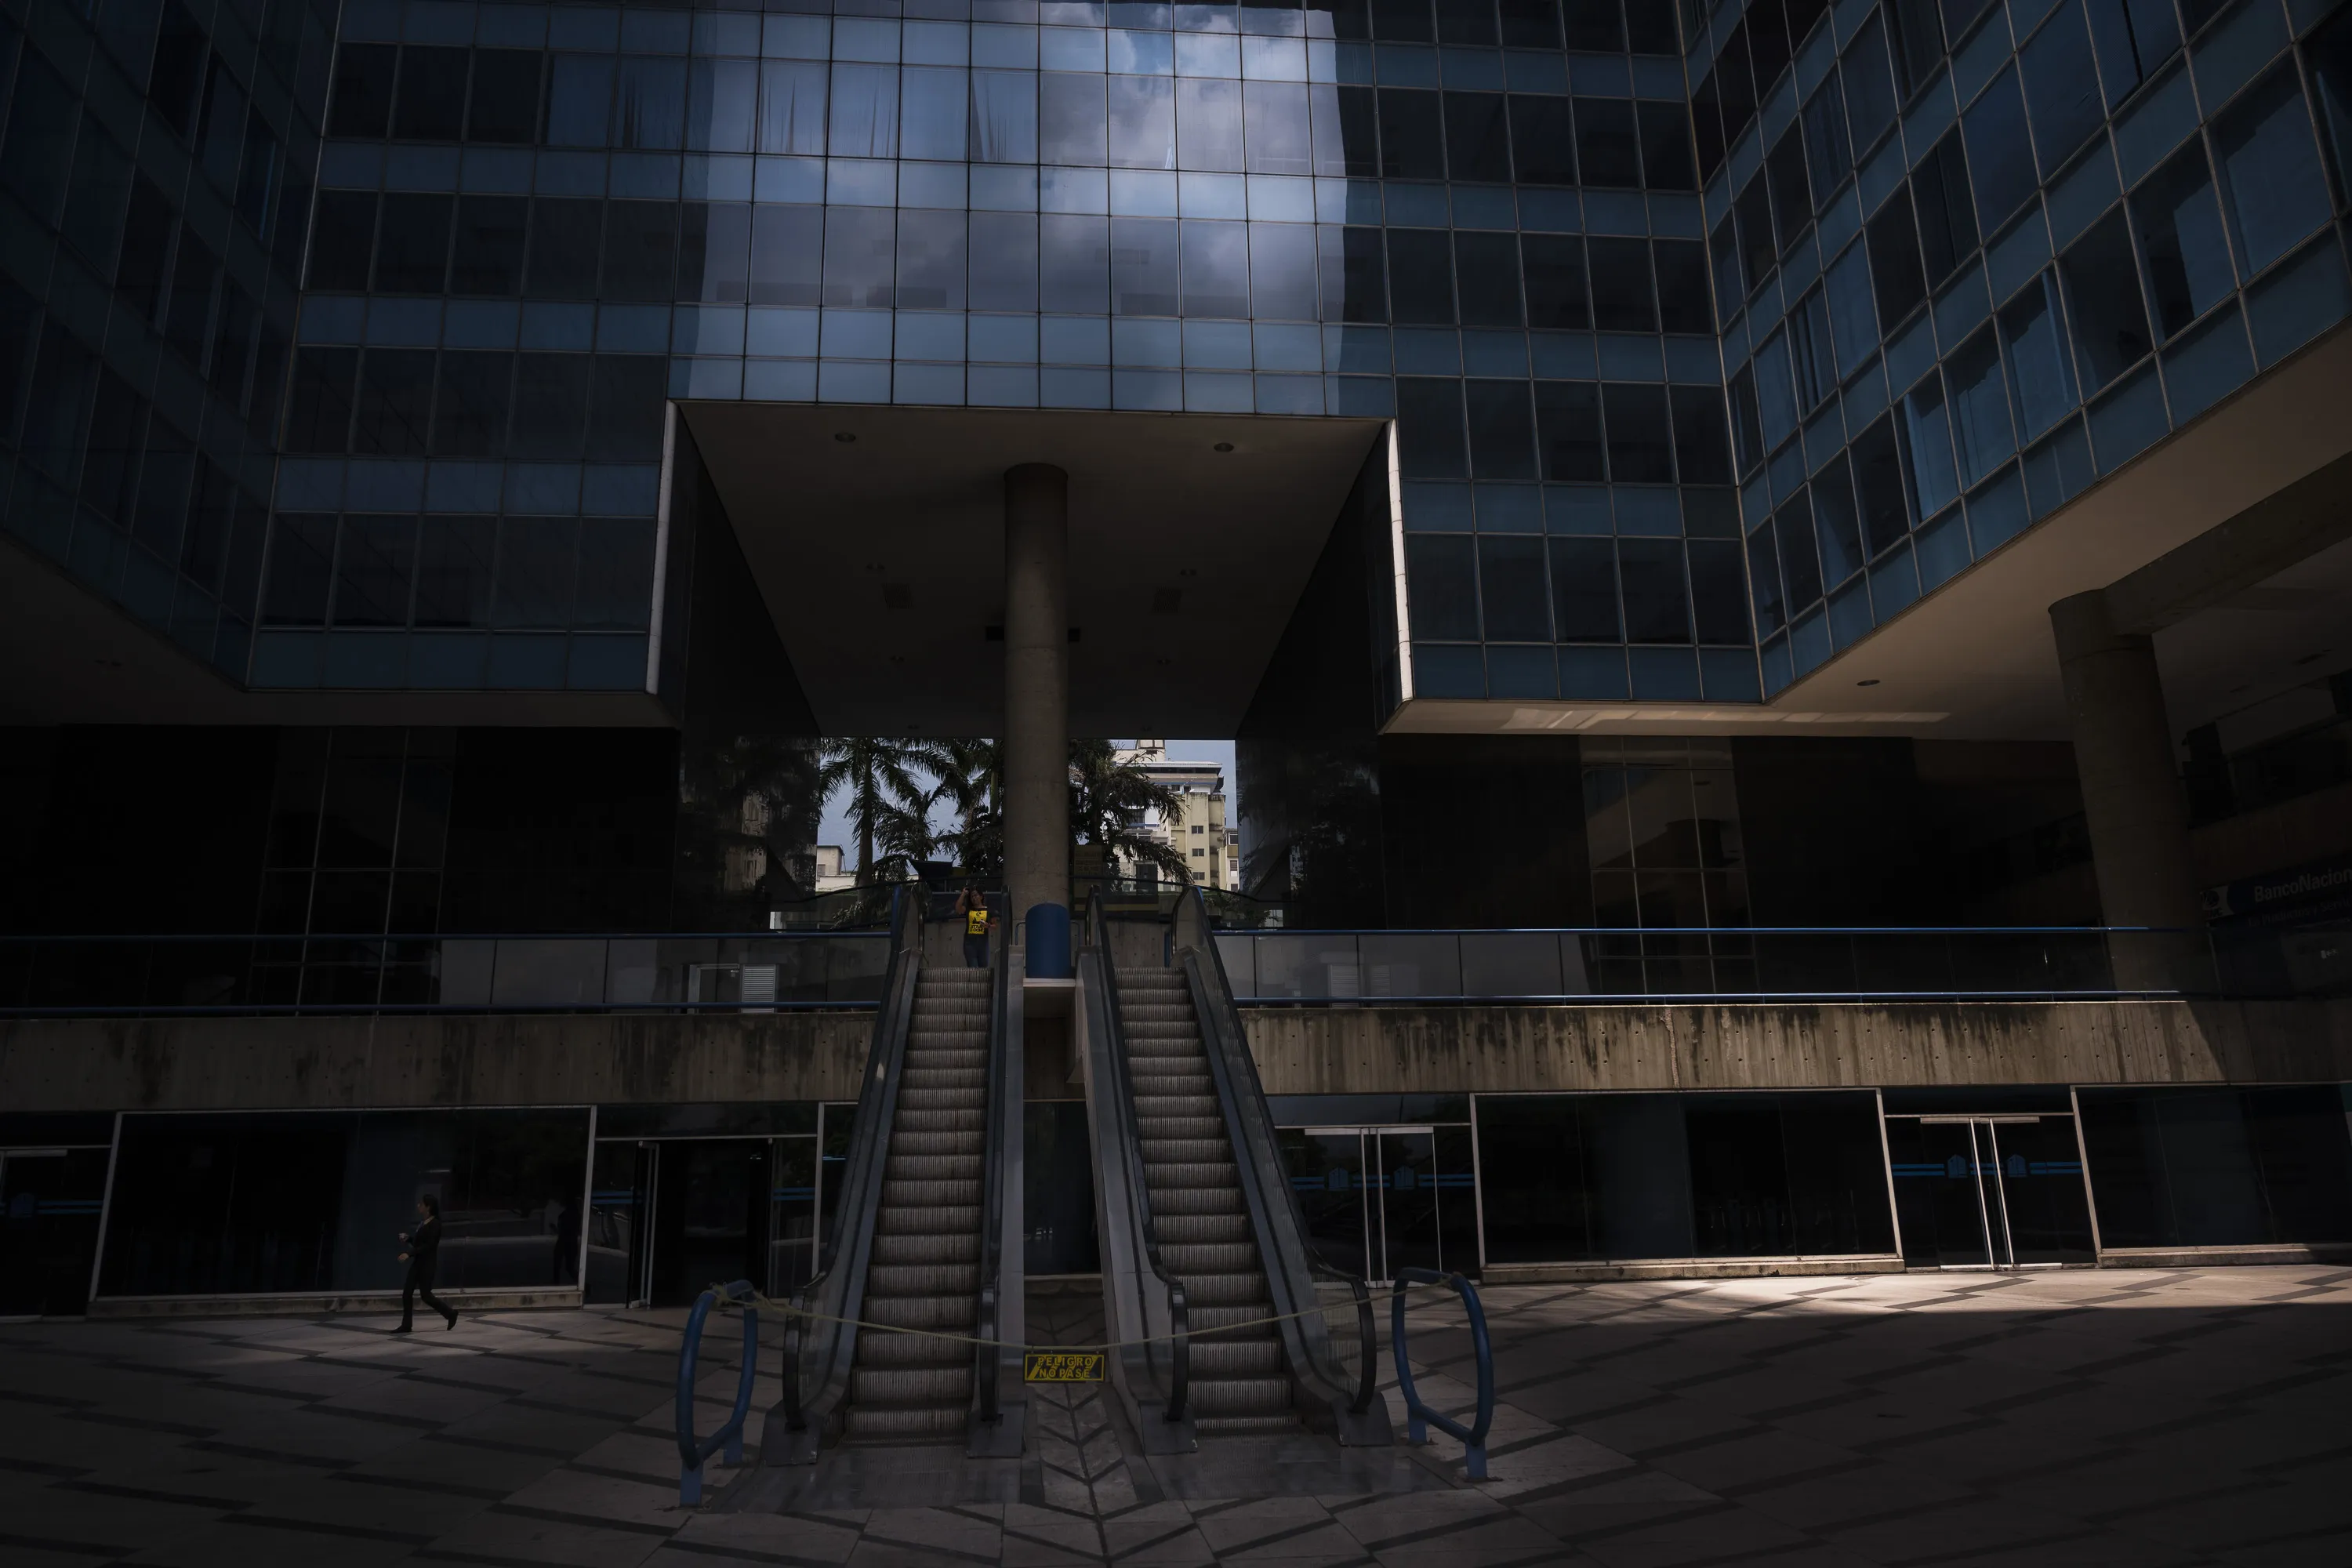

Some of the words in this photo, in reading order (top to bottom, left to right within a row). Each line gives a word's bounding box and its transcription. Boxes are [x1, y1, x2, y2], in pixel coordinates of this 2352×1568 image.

[1037, 1356, 1093, 1367] PELIGRO
[1039, 1369, 1056, 1378] NO
[1059, 1369, 1091, 1378] PASE
